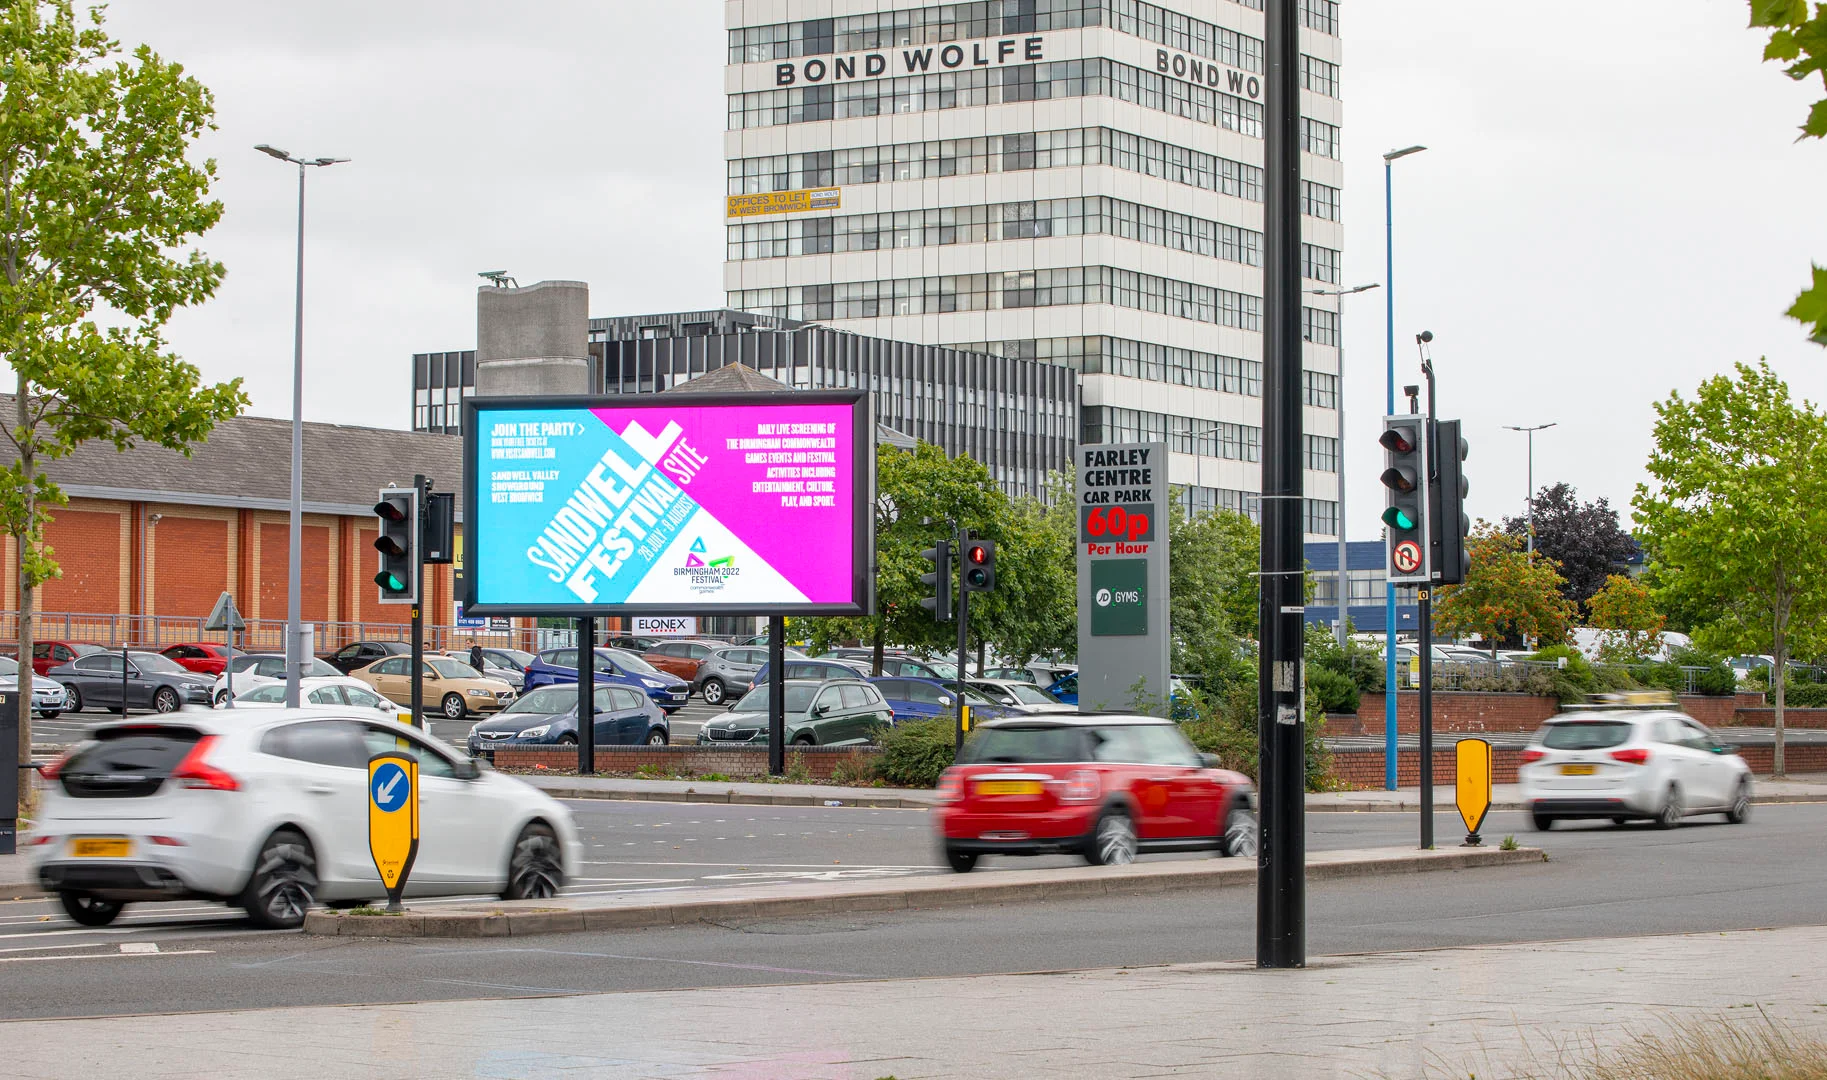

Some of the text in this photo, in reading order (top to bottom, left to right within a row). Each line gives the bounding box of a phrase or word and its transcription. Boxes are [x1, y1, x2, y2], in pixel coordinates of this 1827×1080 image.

[775, 36, 1044, 86] BOND WOLFE
[1156, 48, 1220, 87] BOND
[729, 195, 770, 207] OFFICES
[773, 193, 787, 203] TO
[789, 192, 807, 202] LET
[729, 207, 737, 215] IN
[740, 205, 762, 214] WEST
[763, 201, 807, 213] BROMWICH
[491, 422, 576, 437] JOIN THE PARTY
[757, 422, 836, 435] DAILY LIVE SCREENING OF
[726, 437, 836, 450] THE BIRMINGHAM COMMONWEALTH
[745, 451, 836, 464] GAMES EVENTS AND FESTIVAL
[1085, 449, 1151, 467] FARLEY
[491, 470, 560, 481] SANDWELL VALLEY
[766, 466, 836, 478] ACTIVITIES INCLUDING
[1084, 468, 1152, 487] CENTRE
[491, 481, 545, 491] SHOWGROUND
[752, 481, 836, 493] ENTERTAINMENT, CULTURE,
[527, 419, 684, 583] SANDWELL
[781, 495, 836, 508] PLAY, AND SPORT.
[1083, 489, 1152, 504] CAR PARK
[565, 437, 709, 603] FESTIVAL SITE
[638, 545, 654, 561] 28
[647, 527, 667, 552] JULY
[666, 492, 698, 527] AUGUST
[1087, 505, 1149, 542] 60p
[1087, 541, 1149, 555] Per Hour
[673, 567, 740, 576] BIRMINGHAM 2022
[691, 575, 724, 584] FESTIVAL
[1115, 591, 1139, 603] GYMS
[638, 619, 686, 629] ELONEX
